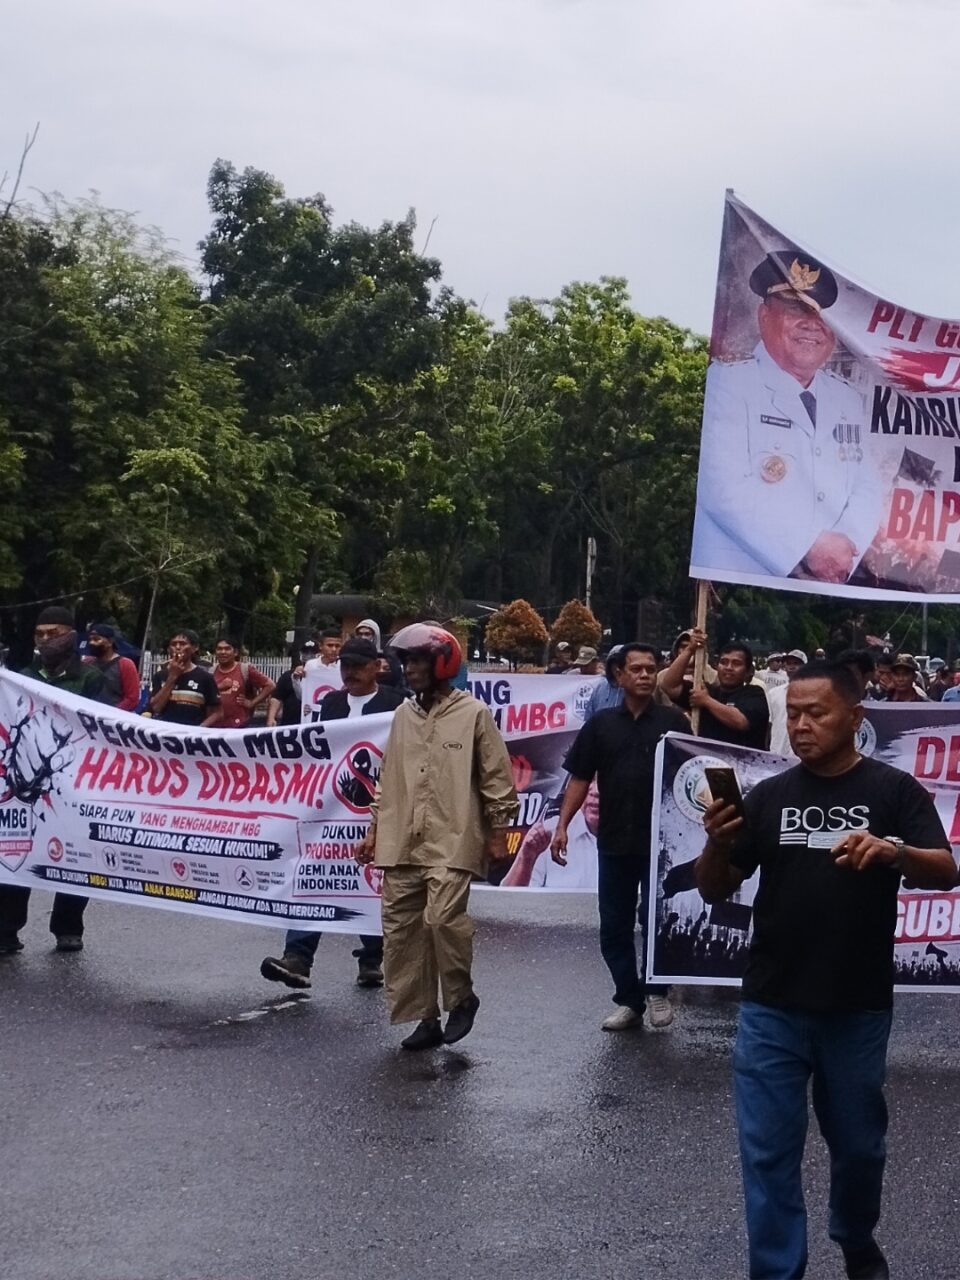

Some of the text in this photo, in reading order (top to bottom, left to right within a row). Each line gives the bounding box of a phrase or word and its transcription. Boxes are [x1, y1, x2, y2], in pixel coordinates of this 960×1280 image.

[506, 701, 567, 733] MBG
[242, 725, 332, 761] MBG
[73, 746, 334, 810] HARUS DIBASMI!
[111, 808, 135, 823] PUN
[139, 811, 167, 828] YANG
[170, 814, 239, 836] MENGHAMBAT
[240, 821, 261, 837] MBG
[779, 804, 870, 832] BOSS
[98, 824, 133, 844] HARUS
[134, 829, 187, 850] DITINDAK
[187, 834, 224, 856] SESUAI
[297, 878, 360, 892] INDONESIA
[299, 864, 361, 878] DEMI ANAK
